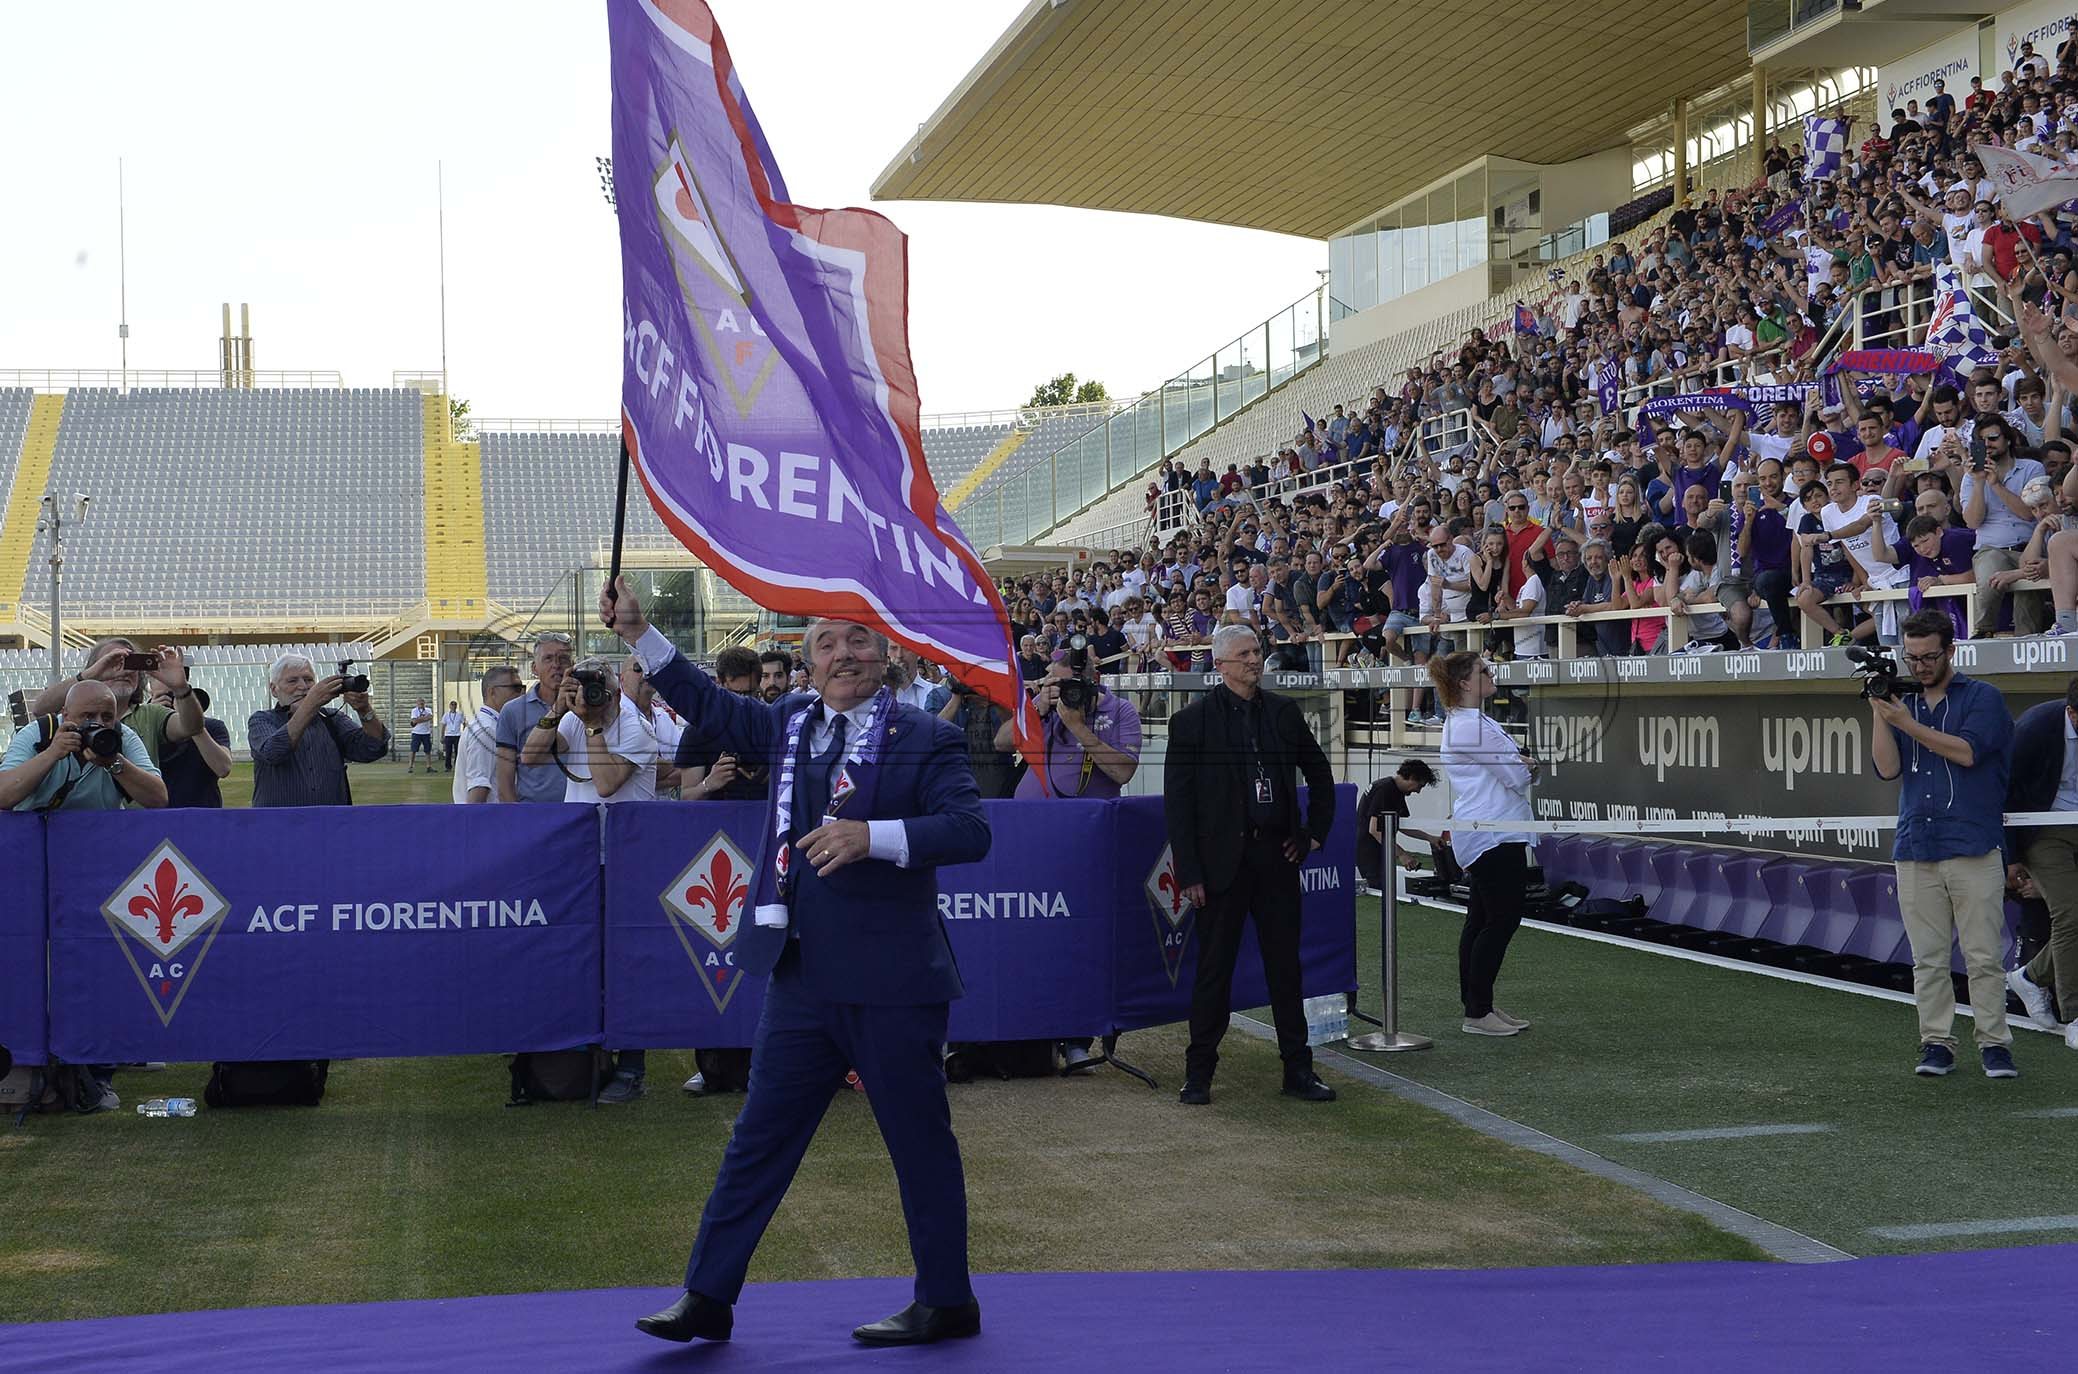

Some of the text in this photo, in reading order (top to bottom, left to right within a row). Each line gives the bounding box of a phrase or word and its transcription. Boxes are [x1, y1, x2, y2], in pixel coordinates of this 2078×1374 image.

[1898, 57, 1969, 98] ACF FIORENTINA
[624, 296, 675, 400] ACF
[1646, 395, 1724, 411] FIORENTINA
[1731, 385, 1819, 402] ORENT
[1351, 669, 1370, 686] upim
[1382, 669, 1401, 686] upim
[1414, 667, 1432, 684] upi
[1526, 662, 1553, 683] upim
[1569, 660, 1598, 682] upim
[1617, 657, 1648, 681] upim
[1668, 655, 1702, 680] upim
[1724, 654, 1761, 680] upim
[1786, 651, 1826, 677] upim
[1950, 644, 1977, 667] im
[2012, 639, 2066, 671] upim
[1203, 673, 1319, 689] up upim
[1535, 714, 1862, 790] upim upim upim
[1537, 798, 1563, 821] upim
[1569, 801, 1598, 821] upim
[1607, 803, 1638, 821] upim
[1836, 828, 1880, 853] upim
[1300, 866, 1340, 893] NTINA
[247, 898, 548, 933] ACF FIORENTINA
[937, 891, 1070, 920] RENTINA
[149, 963, 184, 978] AC
